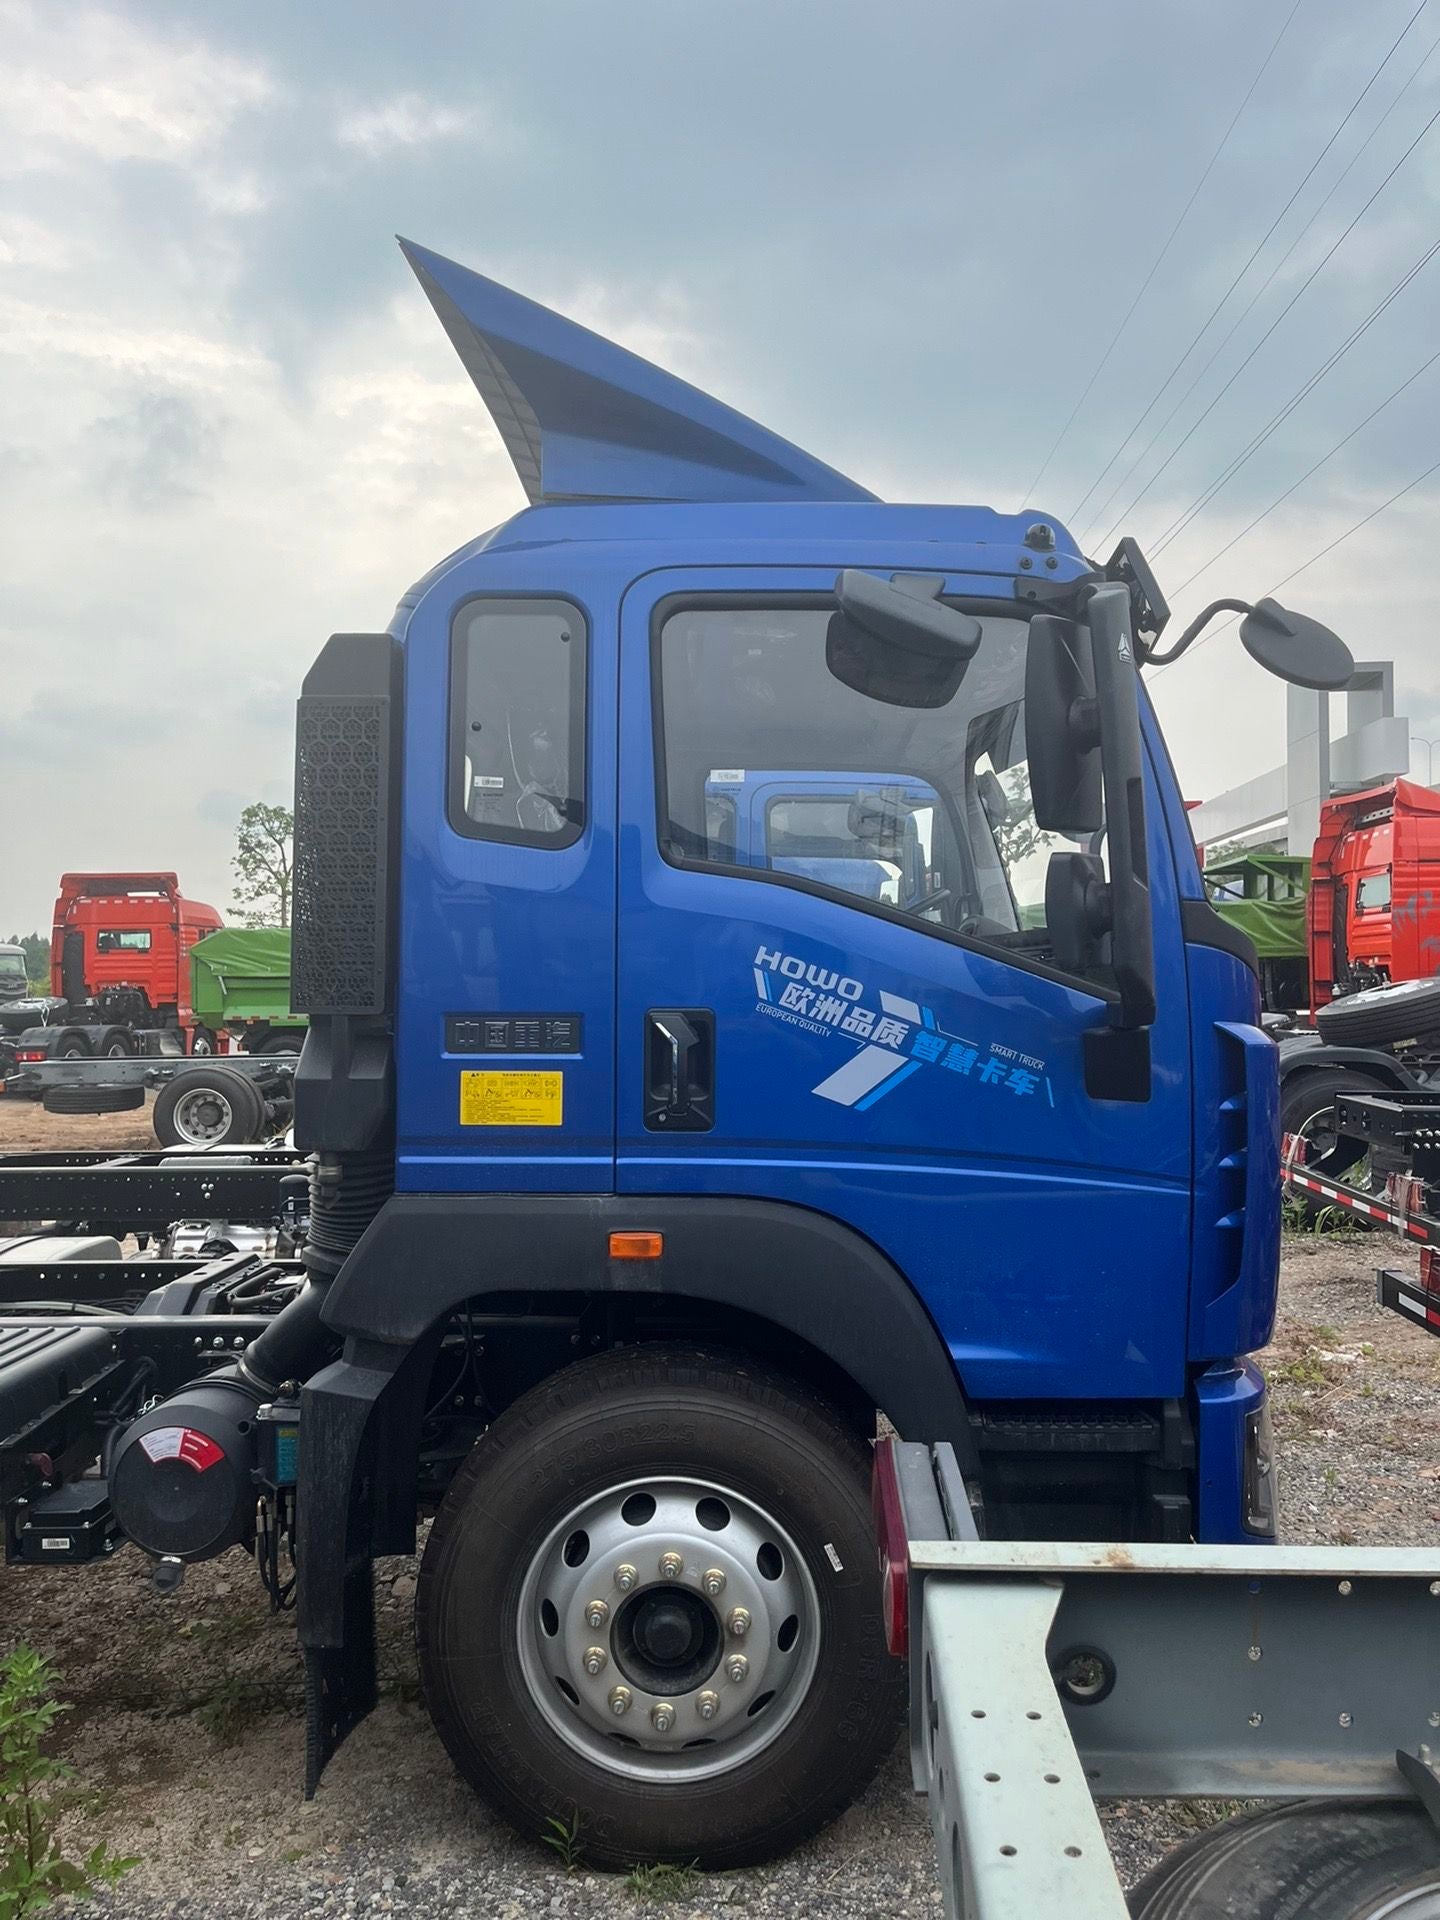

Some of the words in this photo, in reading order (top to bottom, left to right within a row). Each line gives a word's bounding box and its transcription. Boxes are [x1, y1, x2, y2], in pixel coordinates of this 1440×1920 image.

[754, 945, 864, 1001] HOWO
[755, 1003, 797, 1025] EUROPEAN
[798, 1018, 832, 1038] QUALITY
[778, 981, 910, 1049] 欧洲品质
[910, 1030, 1040, 1096] 智慧卡车
[989, 1043, 1018, 1061] SMART
[1018, 1053, 1046, 1072] TRUCK
